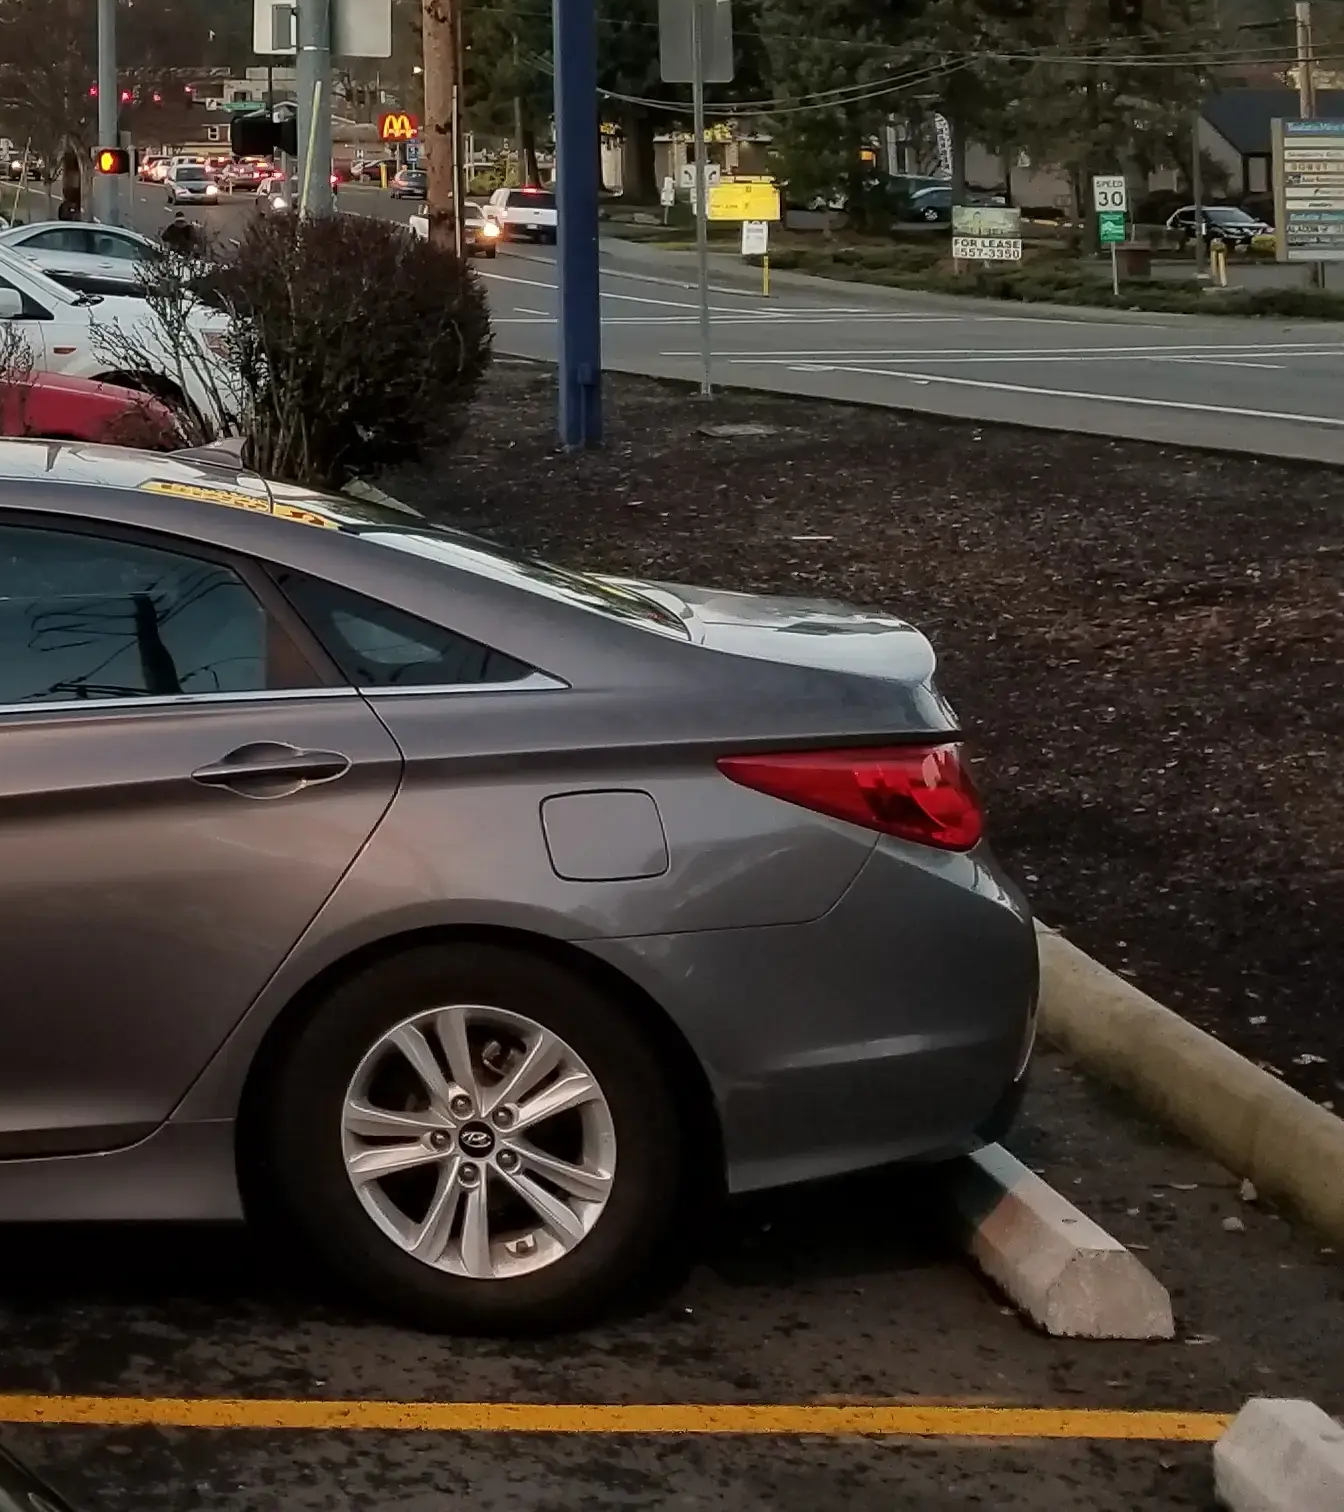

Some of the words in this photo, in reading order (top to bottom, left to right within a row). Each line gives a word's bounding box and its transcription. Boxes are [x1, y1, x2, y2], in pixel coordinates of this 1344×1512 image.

[1096, 180, 1123, 188] SPEED
[1098, 191, 1124, 207] 30
[954, 239, 978, 248] FOR
[980, 239, 1020, 249] LEASE
